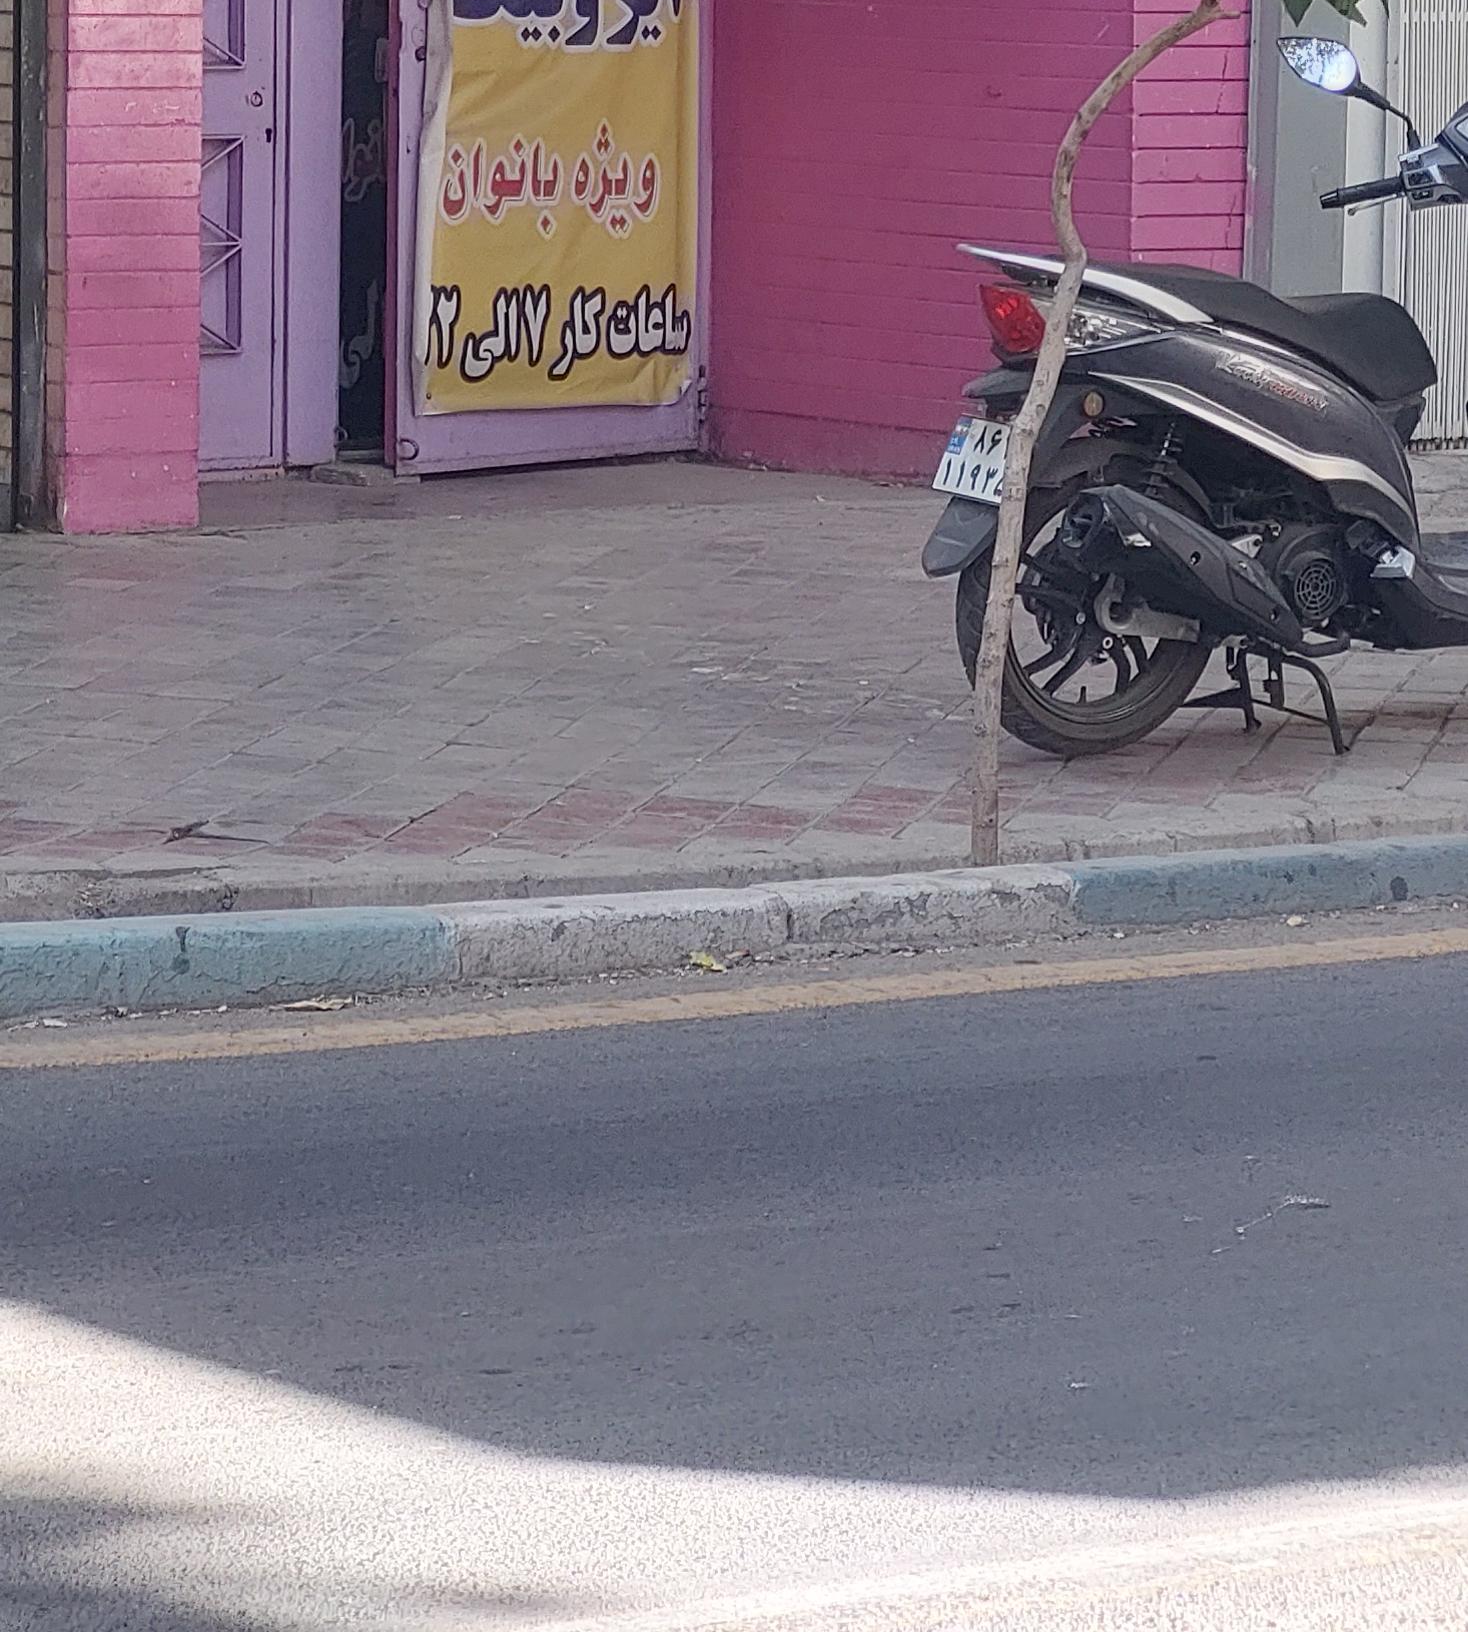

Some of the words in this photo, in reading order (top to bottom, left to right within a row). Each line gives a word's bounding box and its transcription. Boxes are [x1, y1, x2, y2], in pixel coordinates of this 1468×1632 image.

[442, 138, 557, 234] بانوان
[574, 123, 656, 230] ویژه
[548, 285, 605, 380] کار
[608, 284, 691, 356] ساعات
